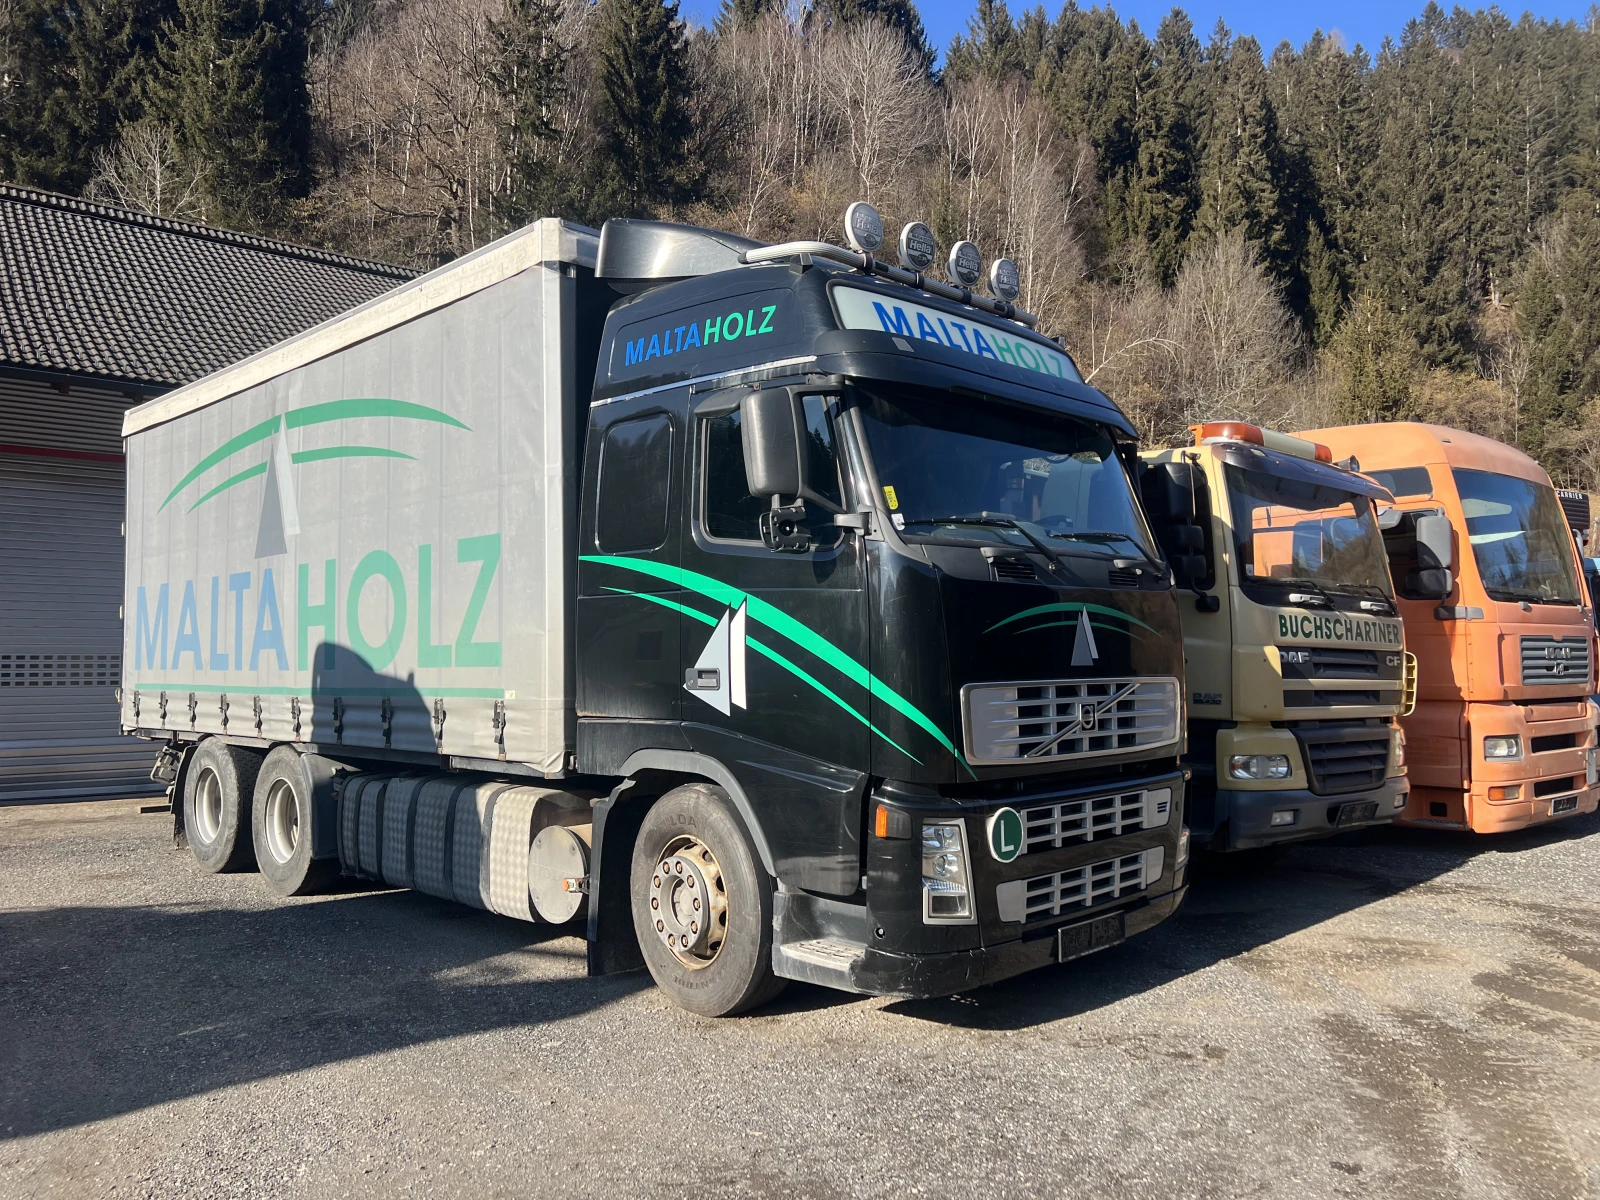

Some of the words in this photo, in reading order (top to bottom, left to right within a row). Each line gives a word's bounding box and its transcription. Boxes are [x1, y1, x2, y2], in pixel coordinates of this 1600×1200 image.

[857, 218, 879, 234] Hella
[909, 239, 931, 254] Hella
[959, 257, 978, 271] Hella
[1001, 275, 1017, 285] Hella
[625, 305, 776, 367] MALTAHOLZ
[872, 301, 1063, 378] MALTAHOLZ
[1556, 490, 1583, 500] CARRIER
[135, 533, 501, 672] MALTAHOLZ
[1278, 614, 1400, 644] BUCHSCHARTNER
[1386, 655, 1401, 667] CF
[1000, 819, 1015, 853] L
